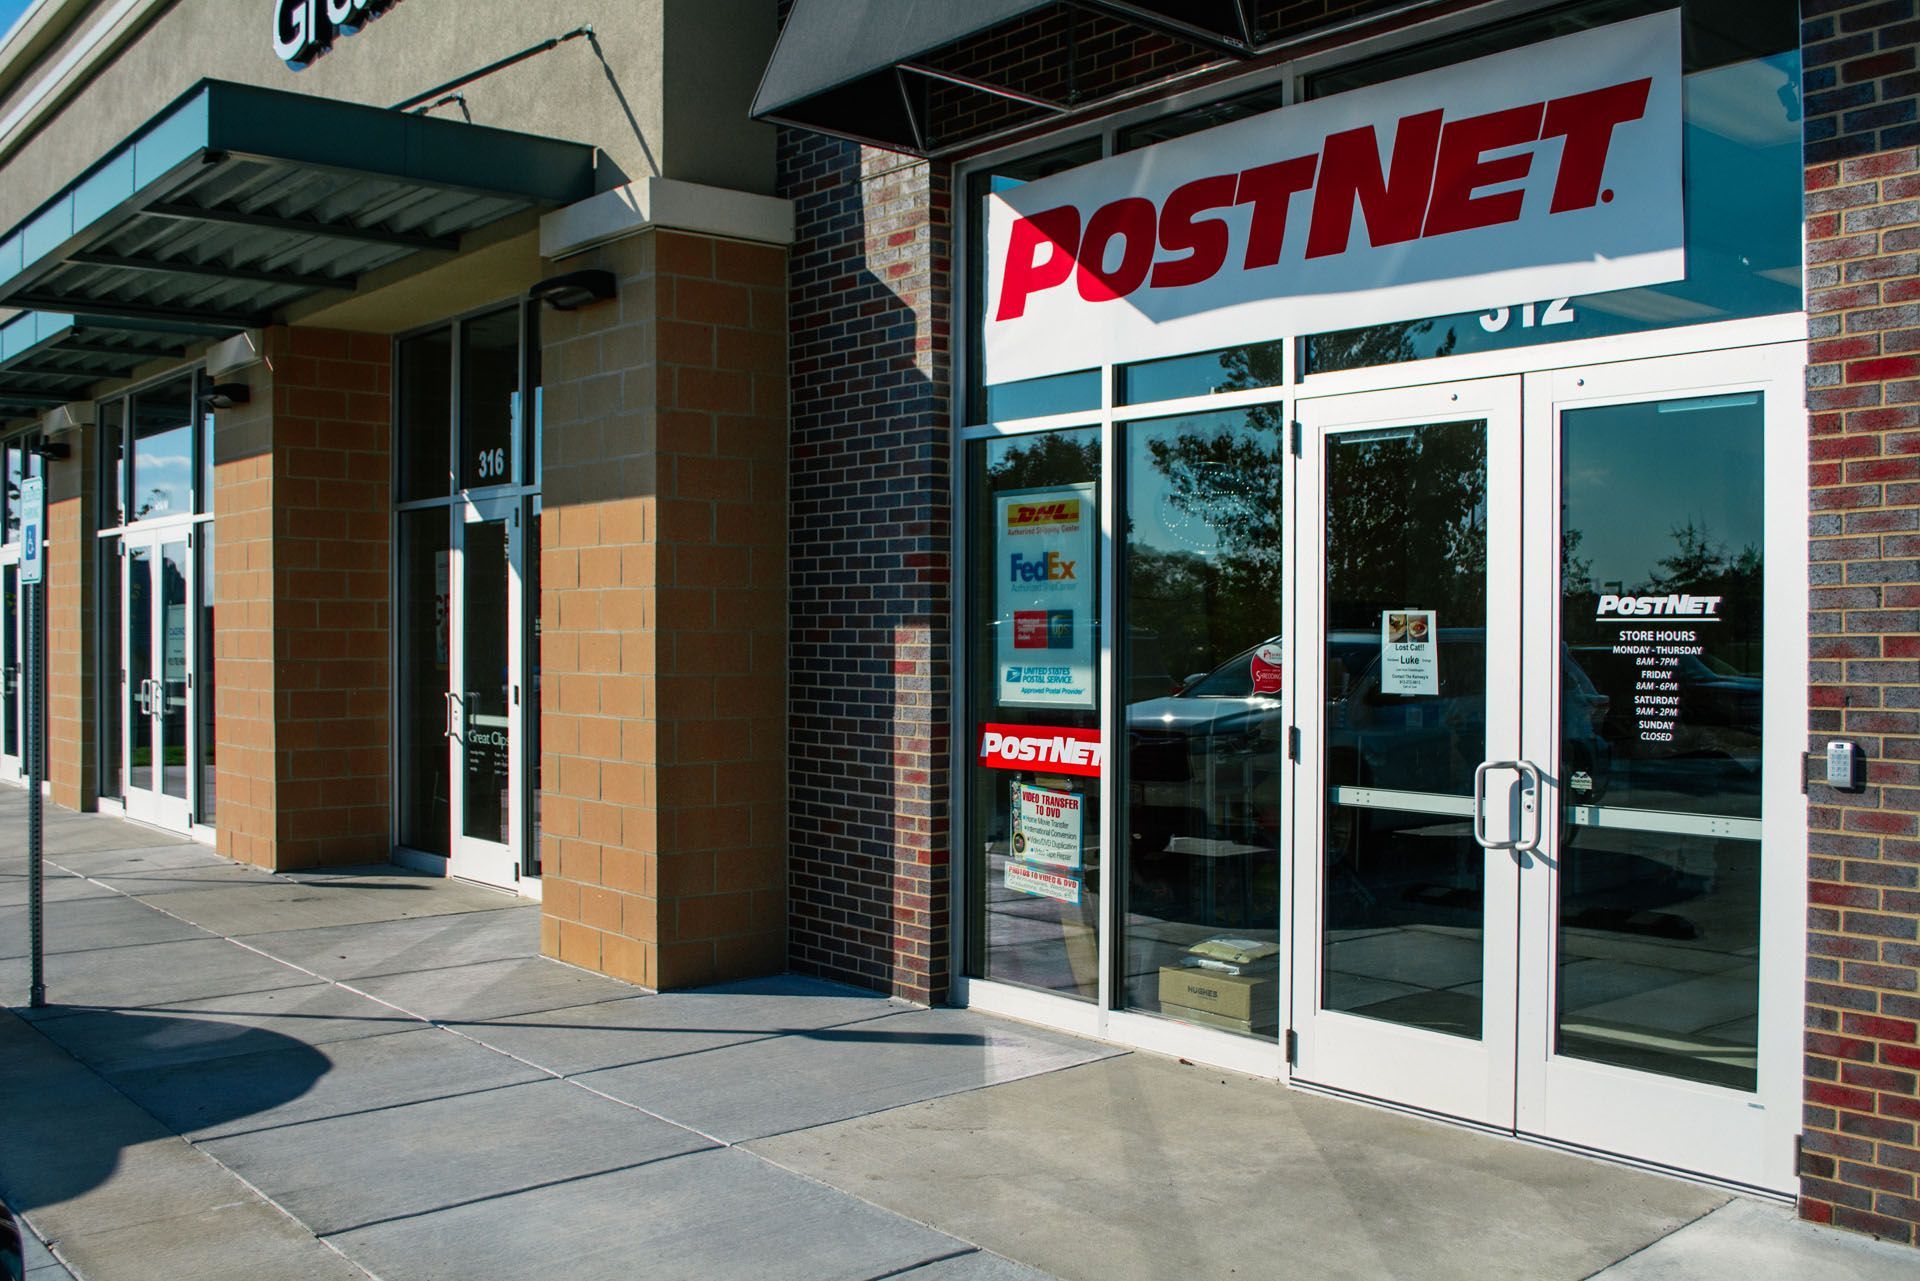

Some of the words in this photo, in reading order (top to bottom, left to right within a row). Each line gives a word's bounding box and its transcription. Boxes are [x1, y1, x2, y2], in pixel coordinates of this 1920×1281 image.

[478, 447, 505, 478] 316
[1017, 503, 1068, 522] DHL
[1011, 552, 1076, 582] FedEx
[1619, 630, 1654, 641] STORE
[1656, 630, 1697, 641] HOURS
[1612, 645, 1650, 654] MONDAY
[1656, 646, 1703, 655] THURSDAY
[1400, 655, 1420, 664] Luke
[1635, 657, 1655, 666] 8AM
[1660, 657, 1679, 666] 7PM
[1024, 667, 1047, 675] UNITED
[1048, 667, 1070, 675] STATES
[1641, 670, 1673, 680] FRIDAY
[1023, 675, 1045, 683] POSTAL
[1635, 681, 1655, 690] 8AM
[1660, 682, 1678, 691] 6PM
[1634, 695, 1679, 705] SATURDAY
[1635, 707, 1655, 716] 9AM
[1660, 707, 1678, 716] 2PM
[1638, 720, 1675, 730] SUNDAY
[468, 730, 490, 744] Great
[1640, 732, 1672, 741] CLOSED
[1022, 791, 1040, 803] VIDEO
[1042, 795, 1078, 809] TRANSFER
[1035, 804, 1044, 815] TO
[1045, 807, 1060, 818] DVD
[1051, 829, 1077, 840] Conversion
[1008, 866, 1030, 877] PHOTOS
[1039, 874, 1056, 883] VIDEO
[1063, 880, 1077, 889] DVD
